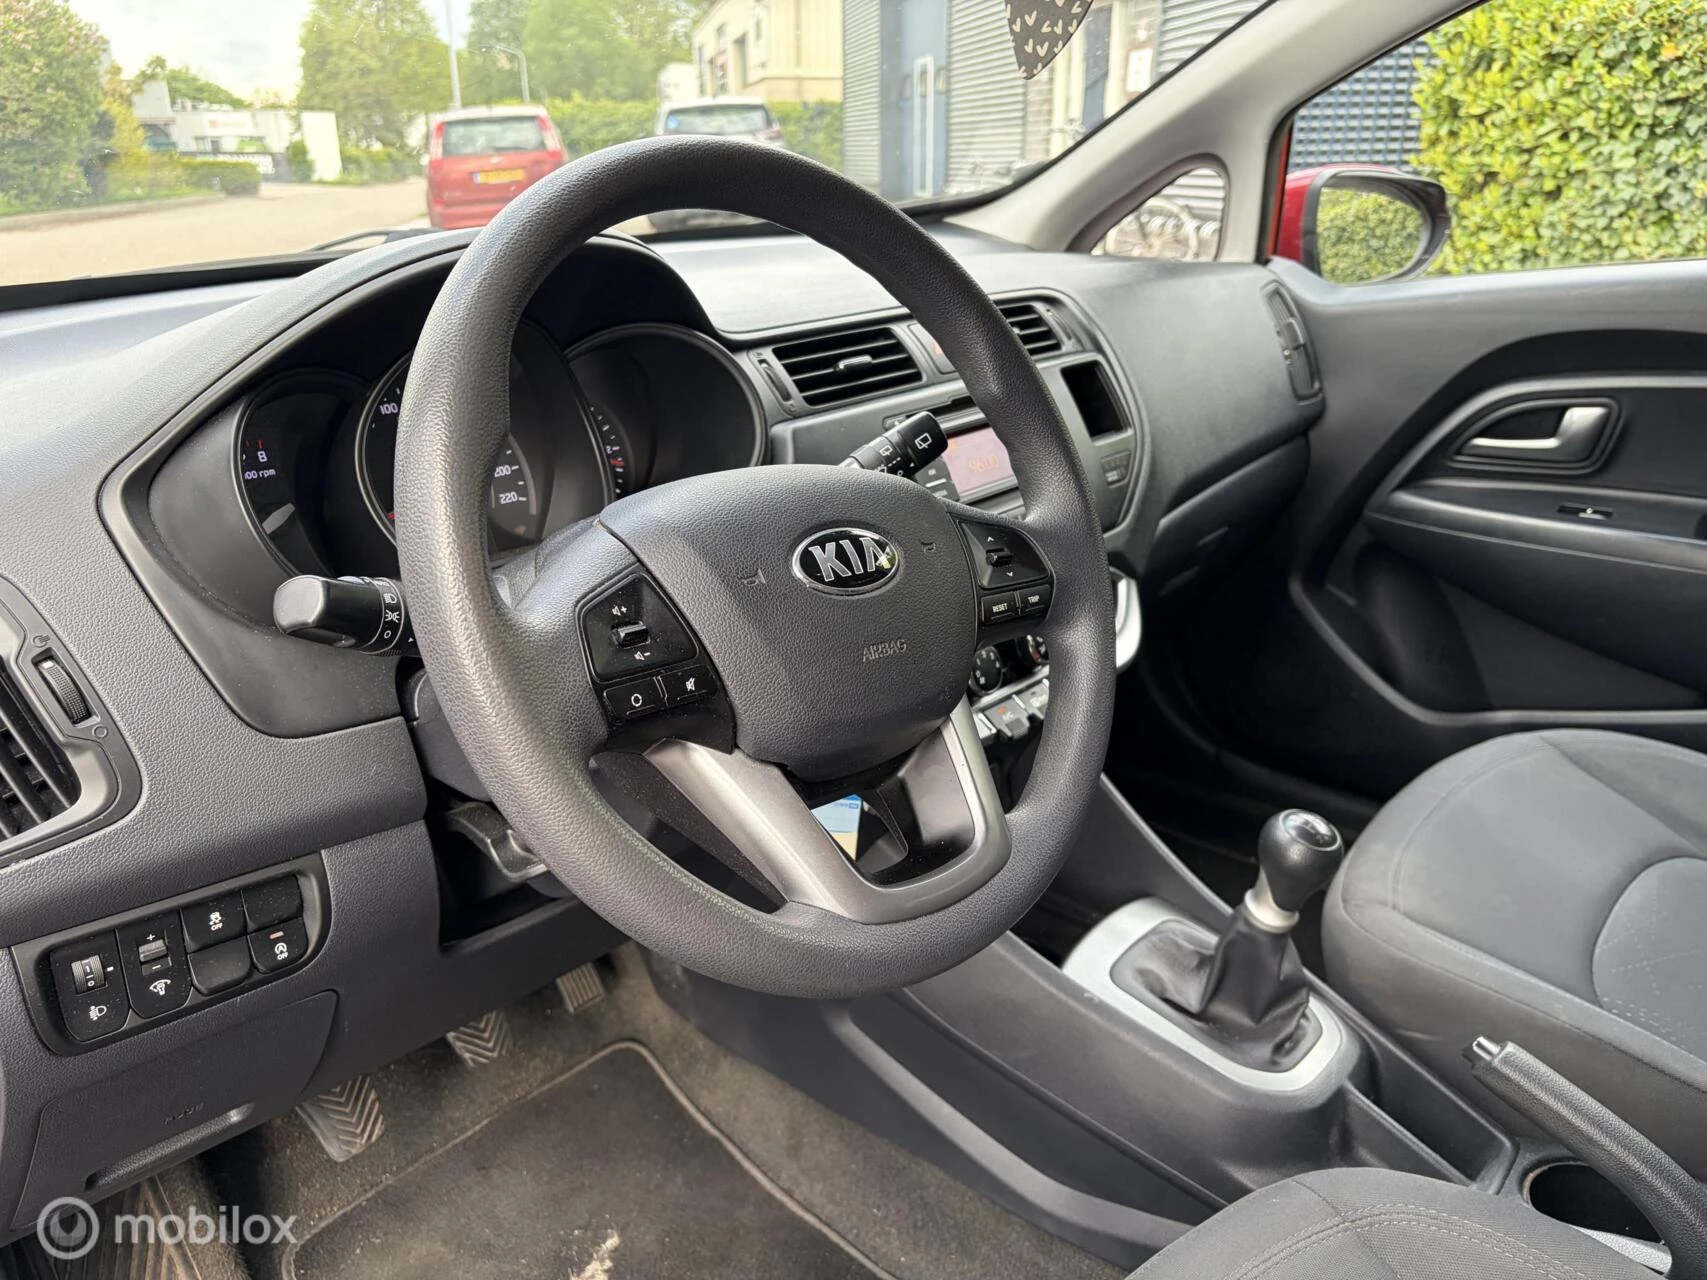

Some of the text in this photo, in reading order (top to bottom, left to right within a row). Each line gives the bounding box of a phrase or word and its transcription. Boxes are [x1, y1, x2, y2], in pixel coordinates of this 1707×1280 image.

[380, 403, 398, 415] 100
[257, 451, 268, 462] 8
[259, 469, 276, 478] rpm
[495, 465, 511, 477] 200
[499, 491, 518, 504] 220
[808, 536, 891, 581] KIA
[992, 603, 1008, 613] RESET
[862, 638, 907, 662] AIRBAG
[210, 922, 223, 931] OFF
[277, 952, 288, 960] OFF
